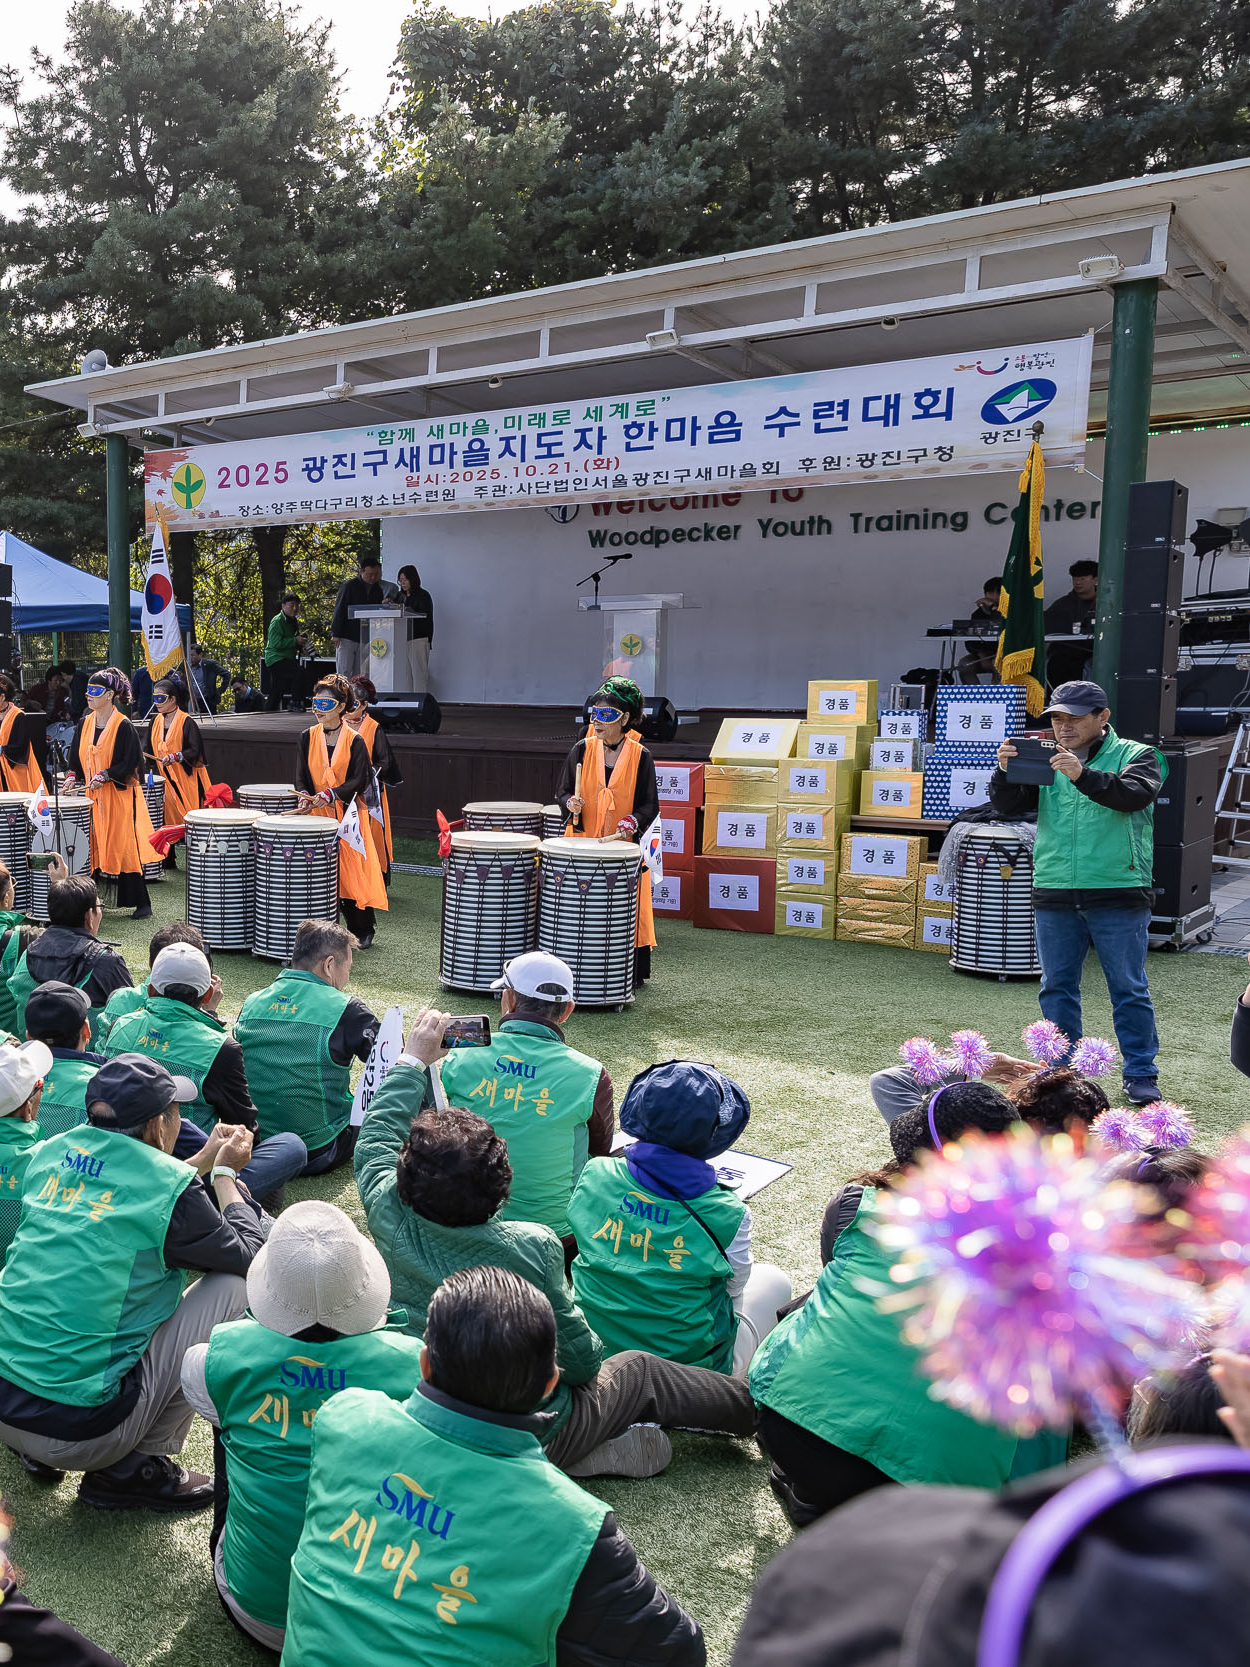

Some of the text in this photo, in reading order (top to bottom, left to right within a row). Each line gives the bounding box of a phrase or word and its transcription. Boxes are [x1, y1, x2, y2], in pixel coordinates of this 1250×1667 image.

[217, 386, 955, 489] 2025 광진구새마을지도자 한마음 수련대회
[588, 522, 742, 549] Woodpecker
[757, 515, 833, 539] Youth
[850, 508, 969, 533] Training
[494, 1057, 538, 1079] SMU
[469, 1078, 555, 1116] 새마을
[61, 1150, 105, 1178] SMU
[36, 1175, 115, 1221] 새마을
[618, 1193, 671, 1226] SMU
[591, 1217, 692, 1270] 새마을
[279, 1361, 347, 1391] SMU
[376, 1475, 456, 1540] SMU
[329, 1509, 478, 1625] 새마을
